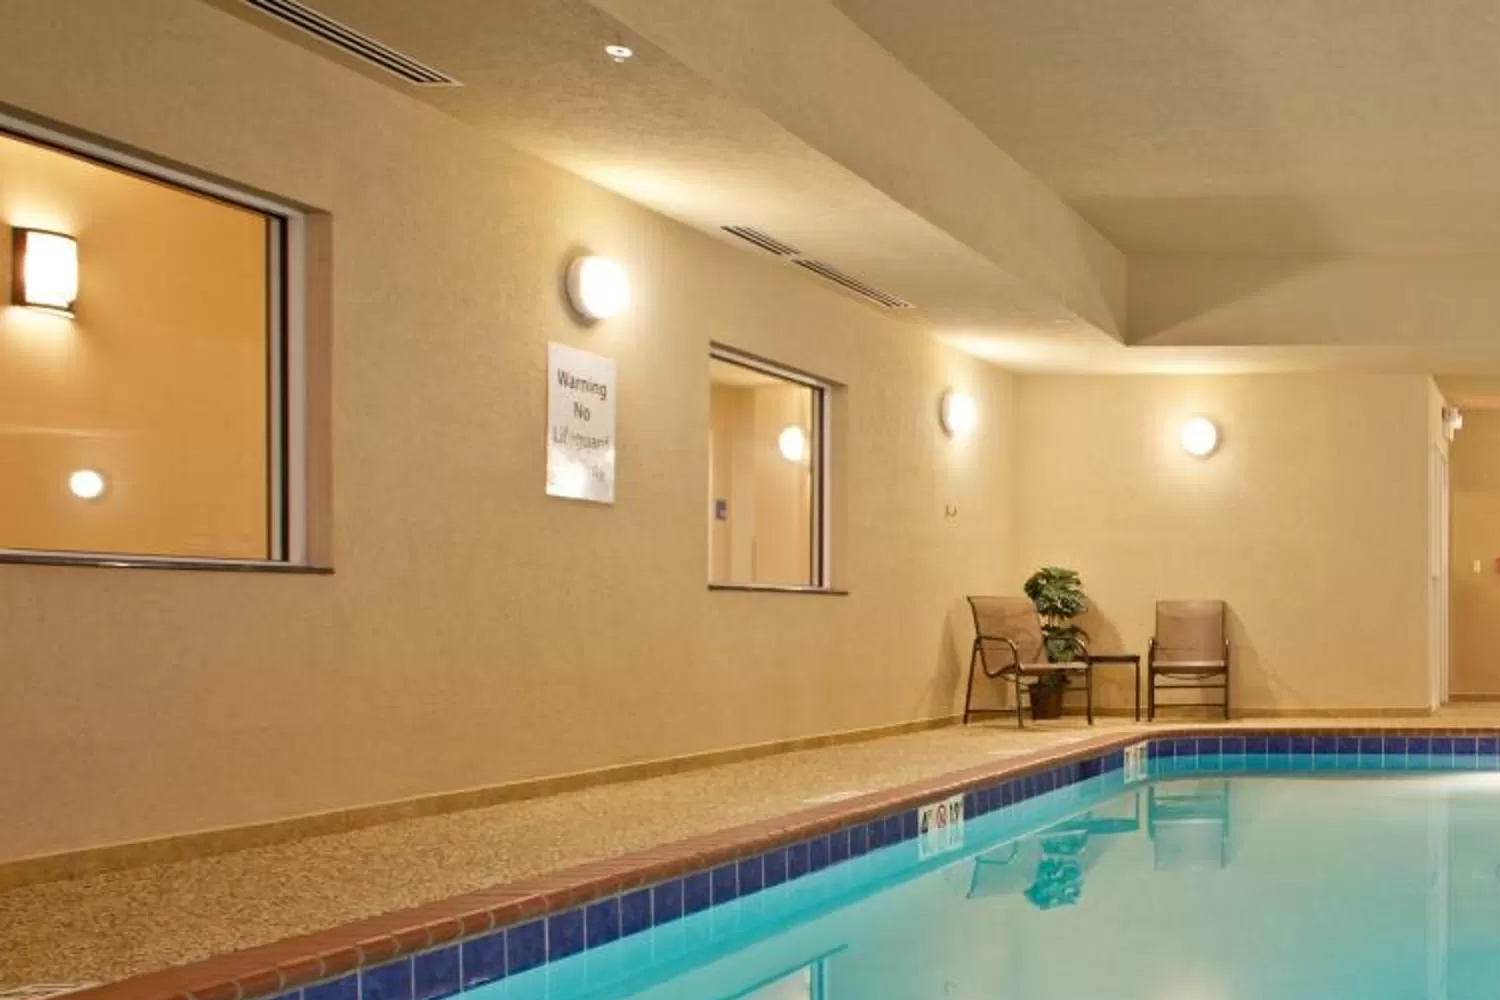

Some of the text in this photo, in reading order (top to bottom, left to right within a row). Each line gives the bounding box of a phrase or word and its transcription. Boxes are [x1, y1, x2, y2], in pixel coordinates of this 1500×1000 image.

[557, 368, 607, 401] Warning
[573, 402, 592, 422] No
[552, 424, 610, 451] Lifguard
